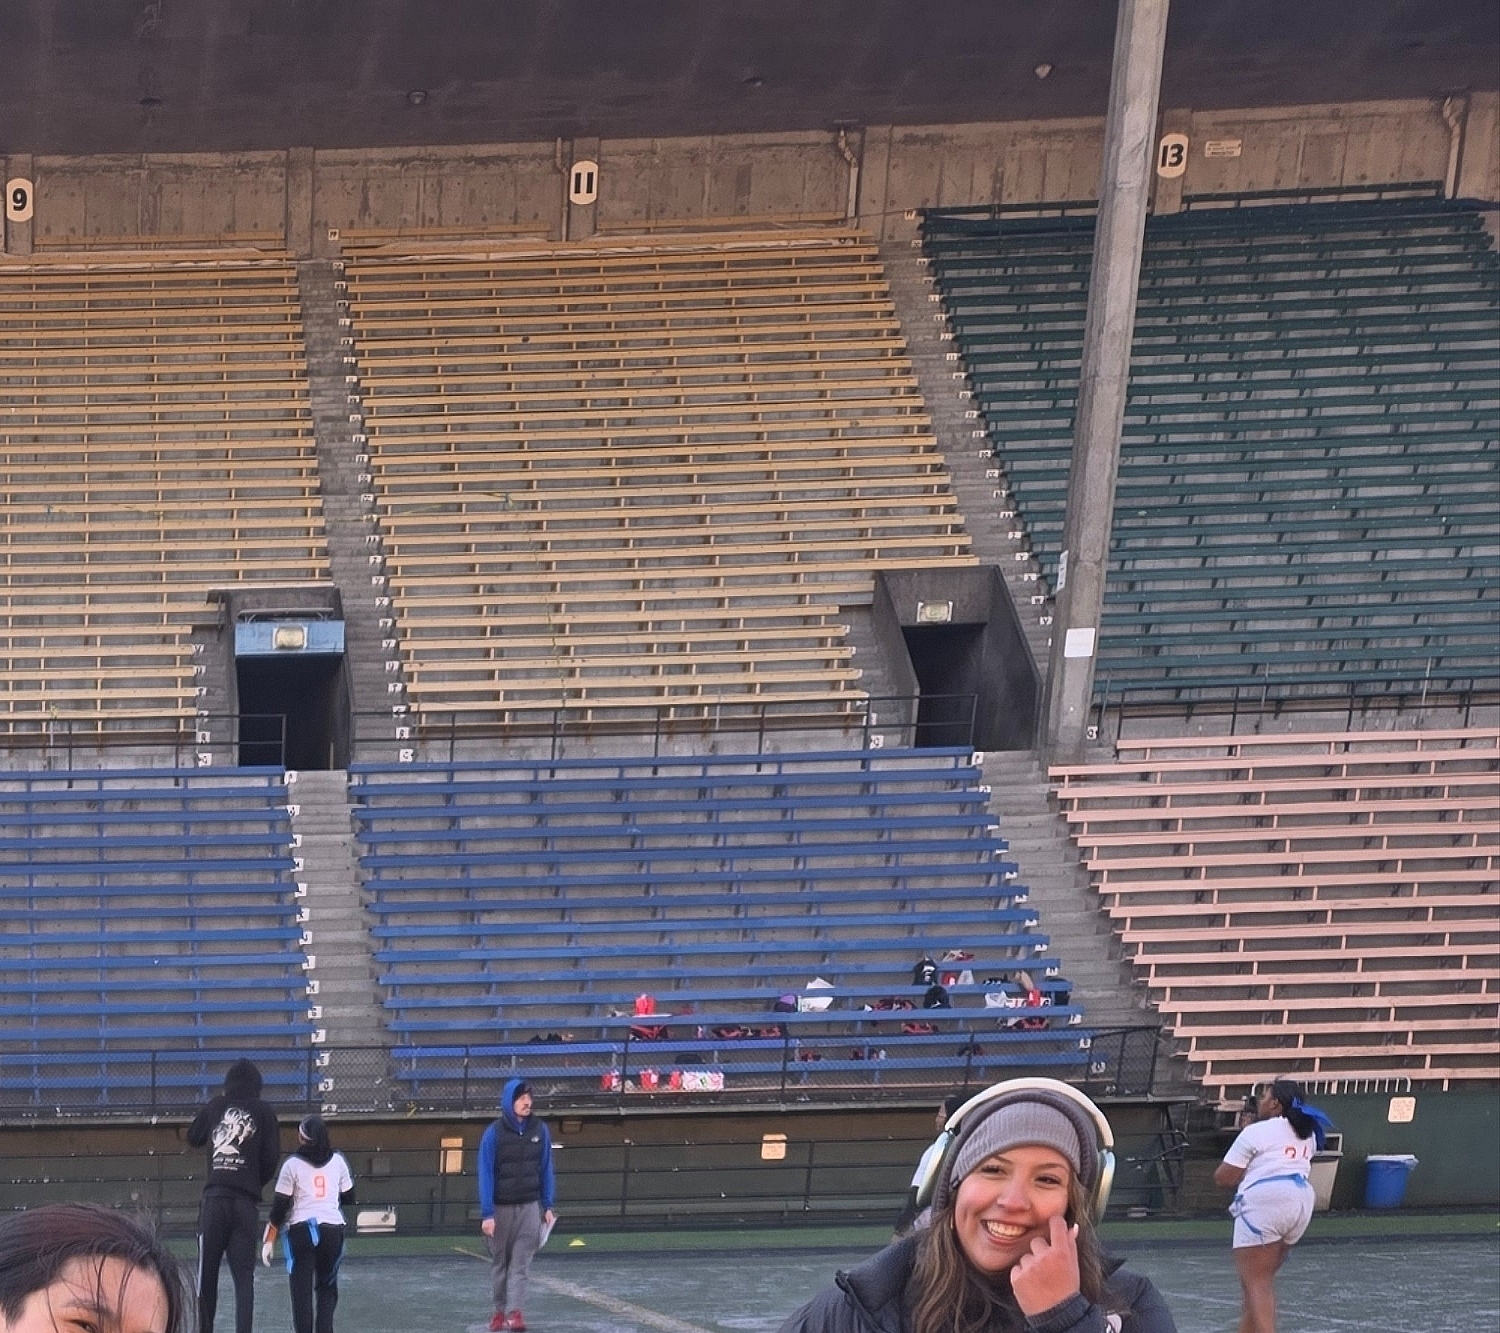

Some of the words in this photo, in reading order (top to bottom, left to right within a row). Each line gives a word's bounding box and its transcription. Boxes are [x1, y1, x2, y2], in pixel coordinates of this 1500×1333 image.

[1161, 143, 1184, 168] 13
[574, 171, 594, 194] 11
[12, 187, 28, 212] 9
[314, 1175, 326, 1198] 9
